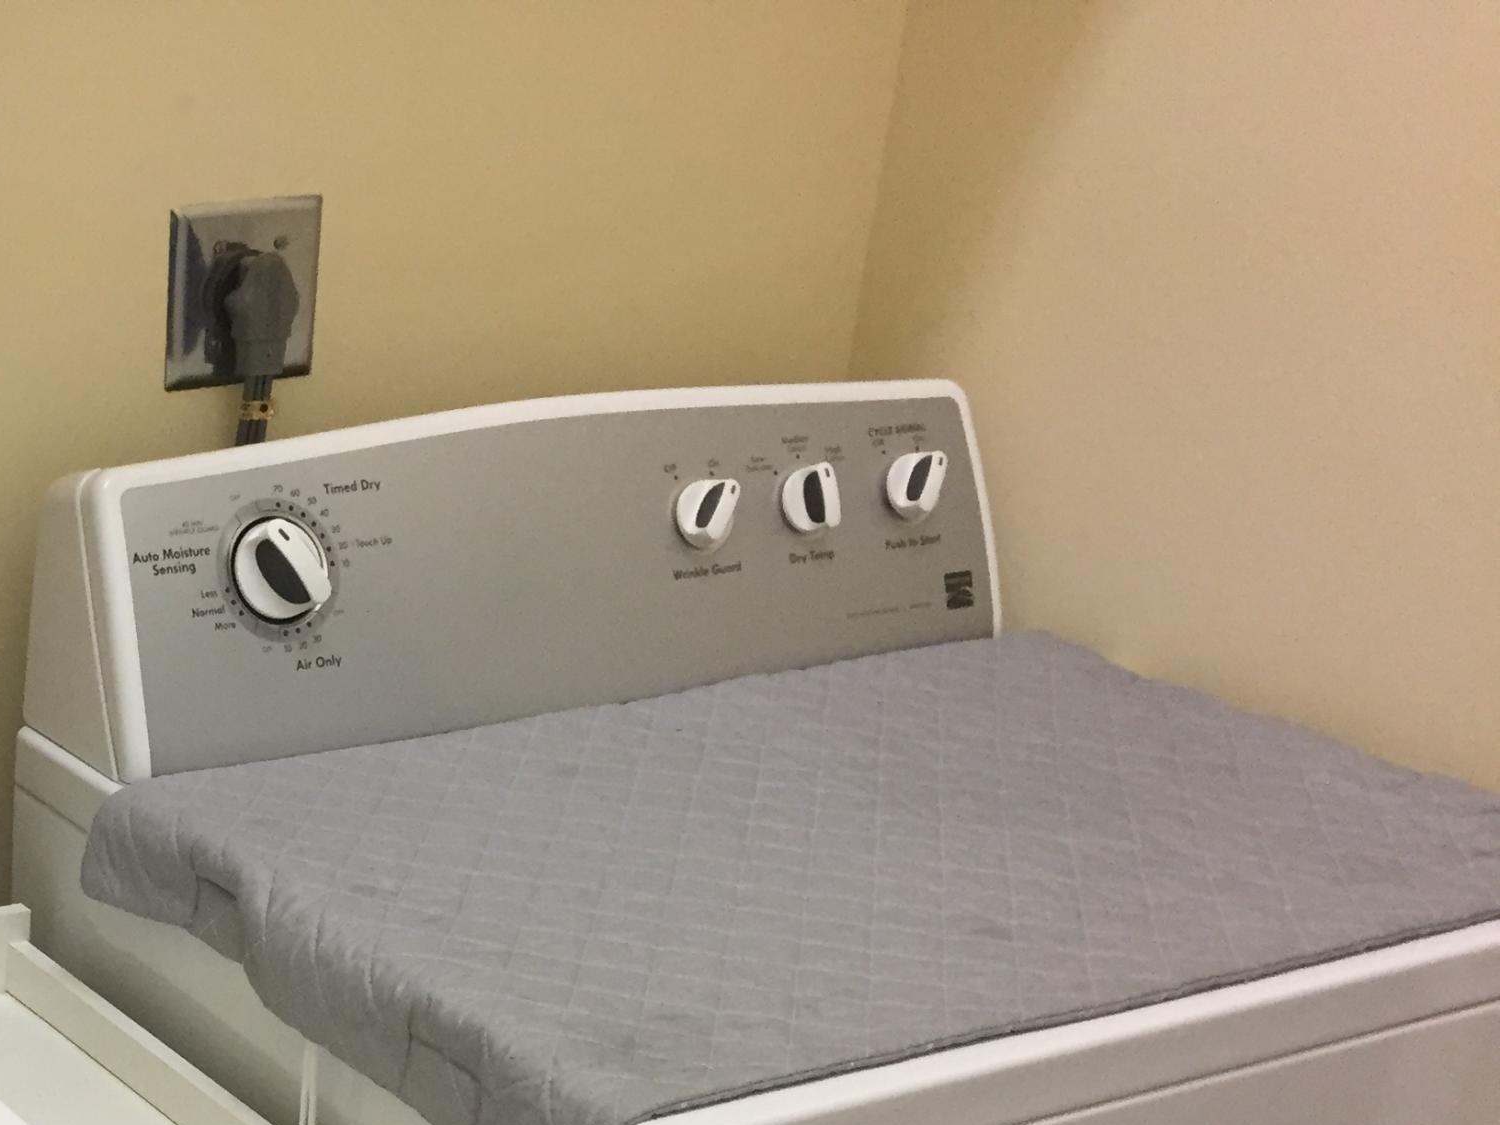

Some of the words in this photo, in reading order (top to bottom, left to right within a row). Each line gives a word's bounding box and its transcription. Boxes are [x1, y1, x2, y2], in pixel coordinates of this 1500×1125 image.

[273, 484, 284, 493] 70
[290, 488, 301, 498] 60
[323, 481, 358, 495] Timed
[360, 479, 381, 492] Dry
[355, 538, 379, 550] Touch
[133, 552, 160, 565] Auto
[162, 545, 211, 561] Moisture
[789, 553, 807, 565] Dry
[809, 550, 835, 562] Temp
[152, 561, 197, 576] Sensing
[672, 564, 710, 580] Wrinkle
[711, 560, 743, 576] Guard
[191, 603, 226, 618] Normal
[214, 621, 237, 631] More
[296, 657, 313, 671] Air
[315, 654, 342, 669] Only
